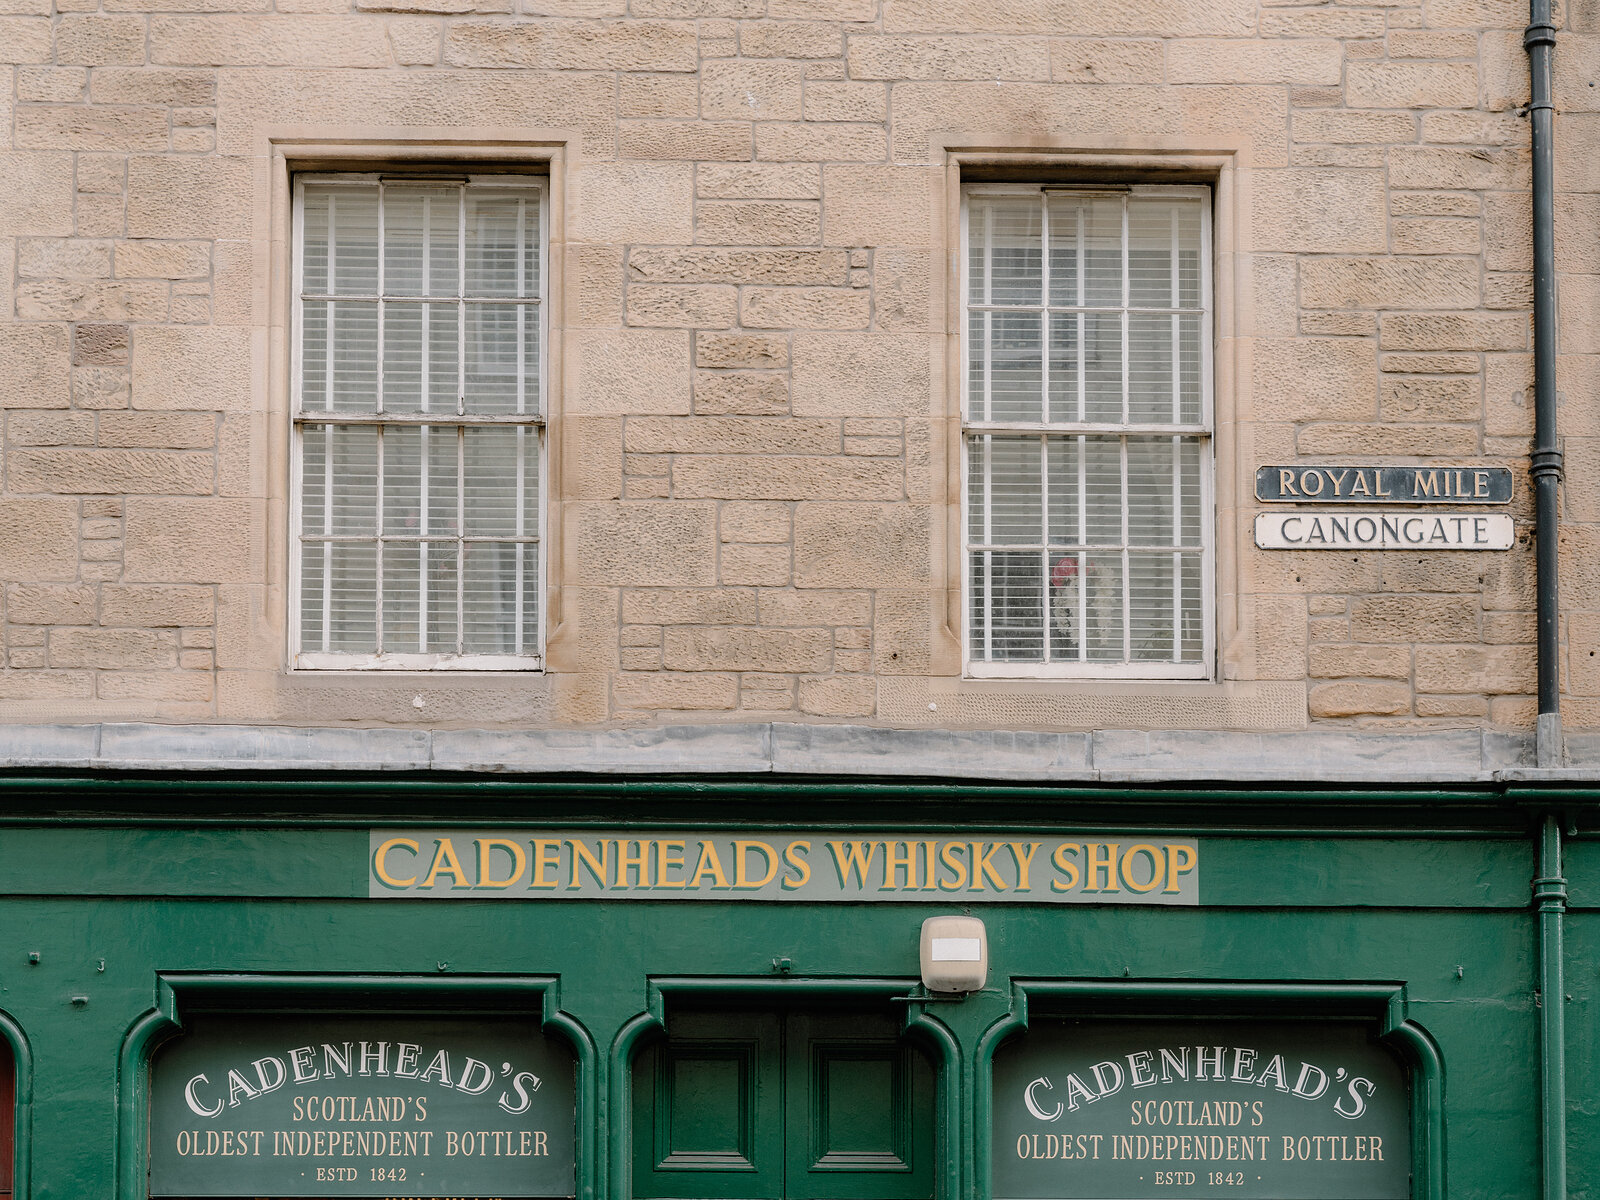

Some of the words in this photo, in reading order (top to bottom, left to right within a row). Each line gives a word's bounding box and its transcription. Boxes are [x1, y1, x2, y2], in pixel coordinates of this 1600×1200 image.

[1278, 469, 1391, 498] ROYAL
[1412, 470, 1490, 498] MILE
[1281, 516, 1489, 544] CANONGATE
[373, 837, 812, 891] CADENHEADS
[828, 840, 1044, 893] WHISKY
[1050, 841, 1199, 895] SHOP
[184, 1041, 542, 1119] CADENHEAD'S
[1023, 1045, 1377, 1123] CADENHEAD'S
[292, 1095, 428, 1122] SCOTLAND'S
[1131, 1100, 1264, 1127] SCOTLAND'S
[176, 1130, 265, 1157] OLDEST
[273, 1130, 433, 1157] INDEPENDENT
[445, 1130, 550, 1157] BOTTLER
[1016, 1134, 1103, 1160] OLDEST
[1112, 1134, 1270, 1161] INDEPENDENT
[1282, 1135, 1385, 1162] BOTTLER
[316, 1167, 358, 1182] ESTD
[370, 1167, 407, 1182] 1842
[1154, 1171, 1196, 1186] ESTD
[1208, 1171, 1245, 1186] 1842
